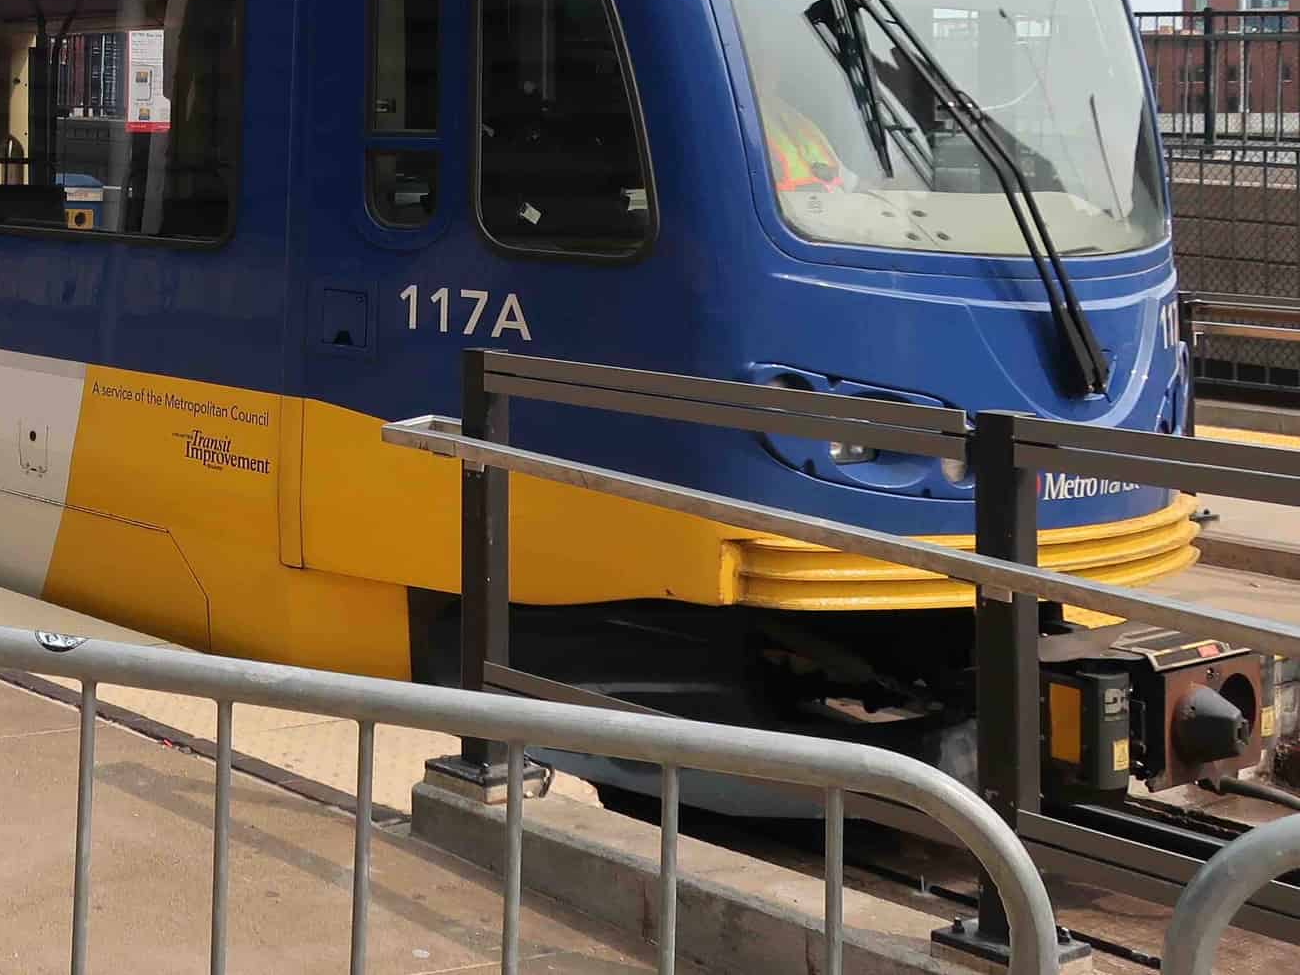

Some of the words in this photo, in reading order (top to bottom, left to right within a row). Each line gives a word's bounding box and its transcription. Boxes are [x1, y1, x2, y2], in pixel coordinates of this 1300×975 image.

[399, 284, 533, 341] 117A
[92, 381, 101, 395] A
[101, 386, 133, 402] service
[134, 388, 147, 403] of
[147, 390, 163, 406] the
[164, 394, 228, 417] Metropolitan
[230, 405, 269, 426] Council
[185, 440, 270, 474] Improvement
[192, 429, 231, 453] Transit
